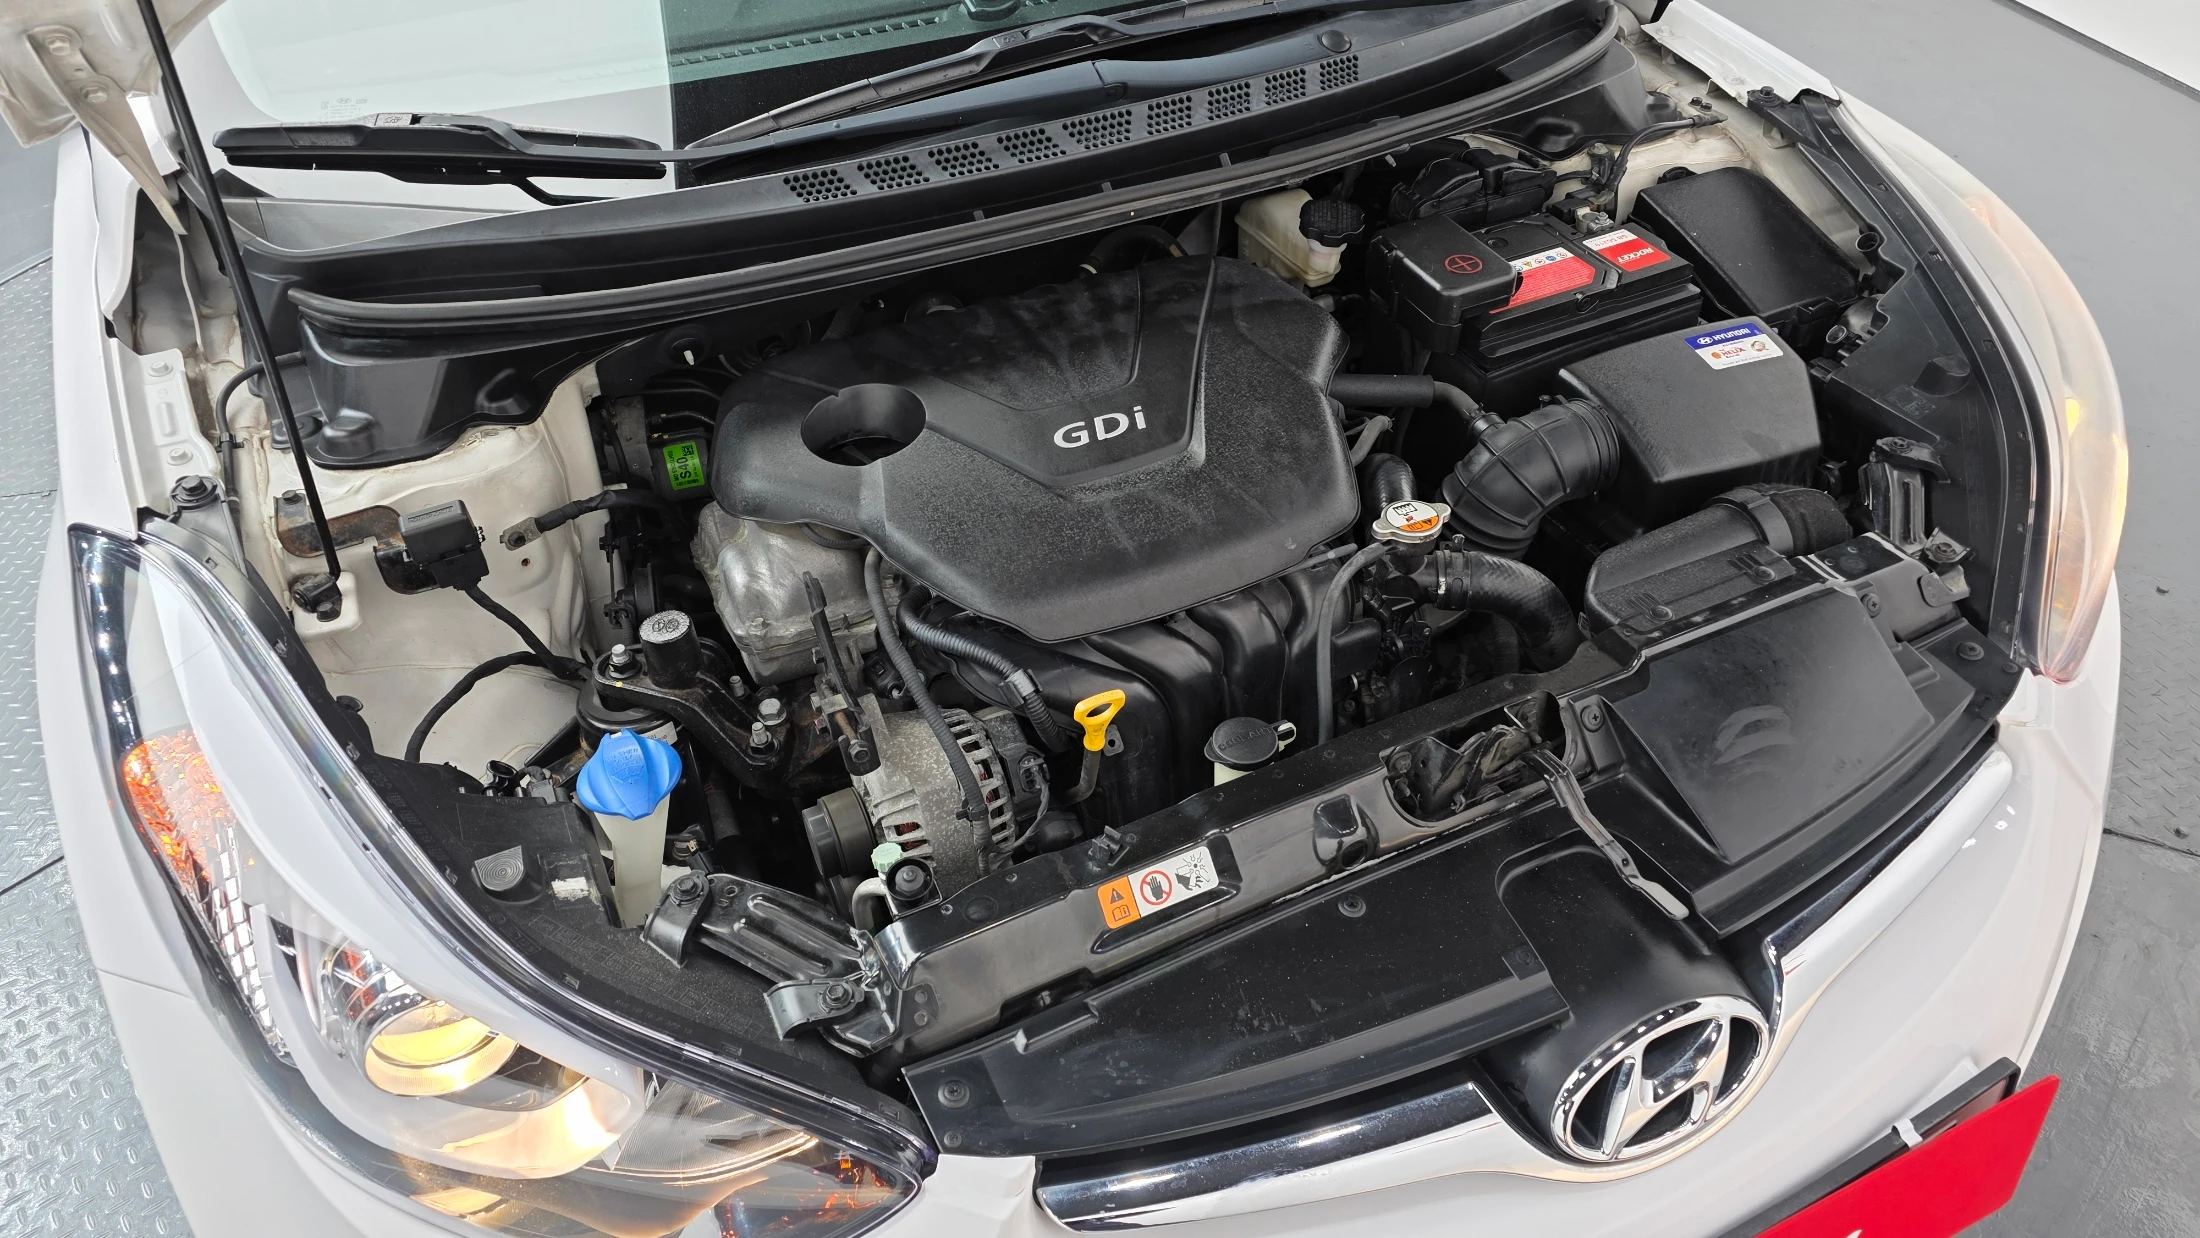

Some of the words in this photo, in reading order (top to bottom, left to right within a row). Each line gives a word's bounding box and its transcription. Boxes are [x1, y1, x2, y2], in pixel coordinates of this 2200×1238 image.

[1616, 247, 1654, 264] ROCKET
[1712, 327, 1751, 341] HYUNDAI
[1721, 347, 1746, 357] HELIX
[1053, 405, 1147, 449] GDi
[676, 456, 692, 479] S40
[1218, 726, 1272, 752] COOLANT
[606, 748, 639, 762] WASHER
